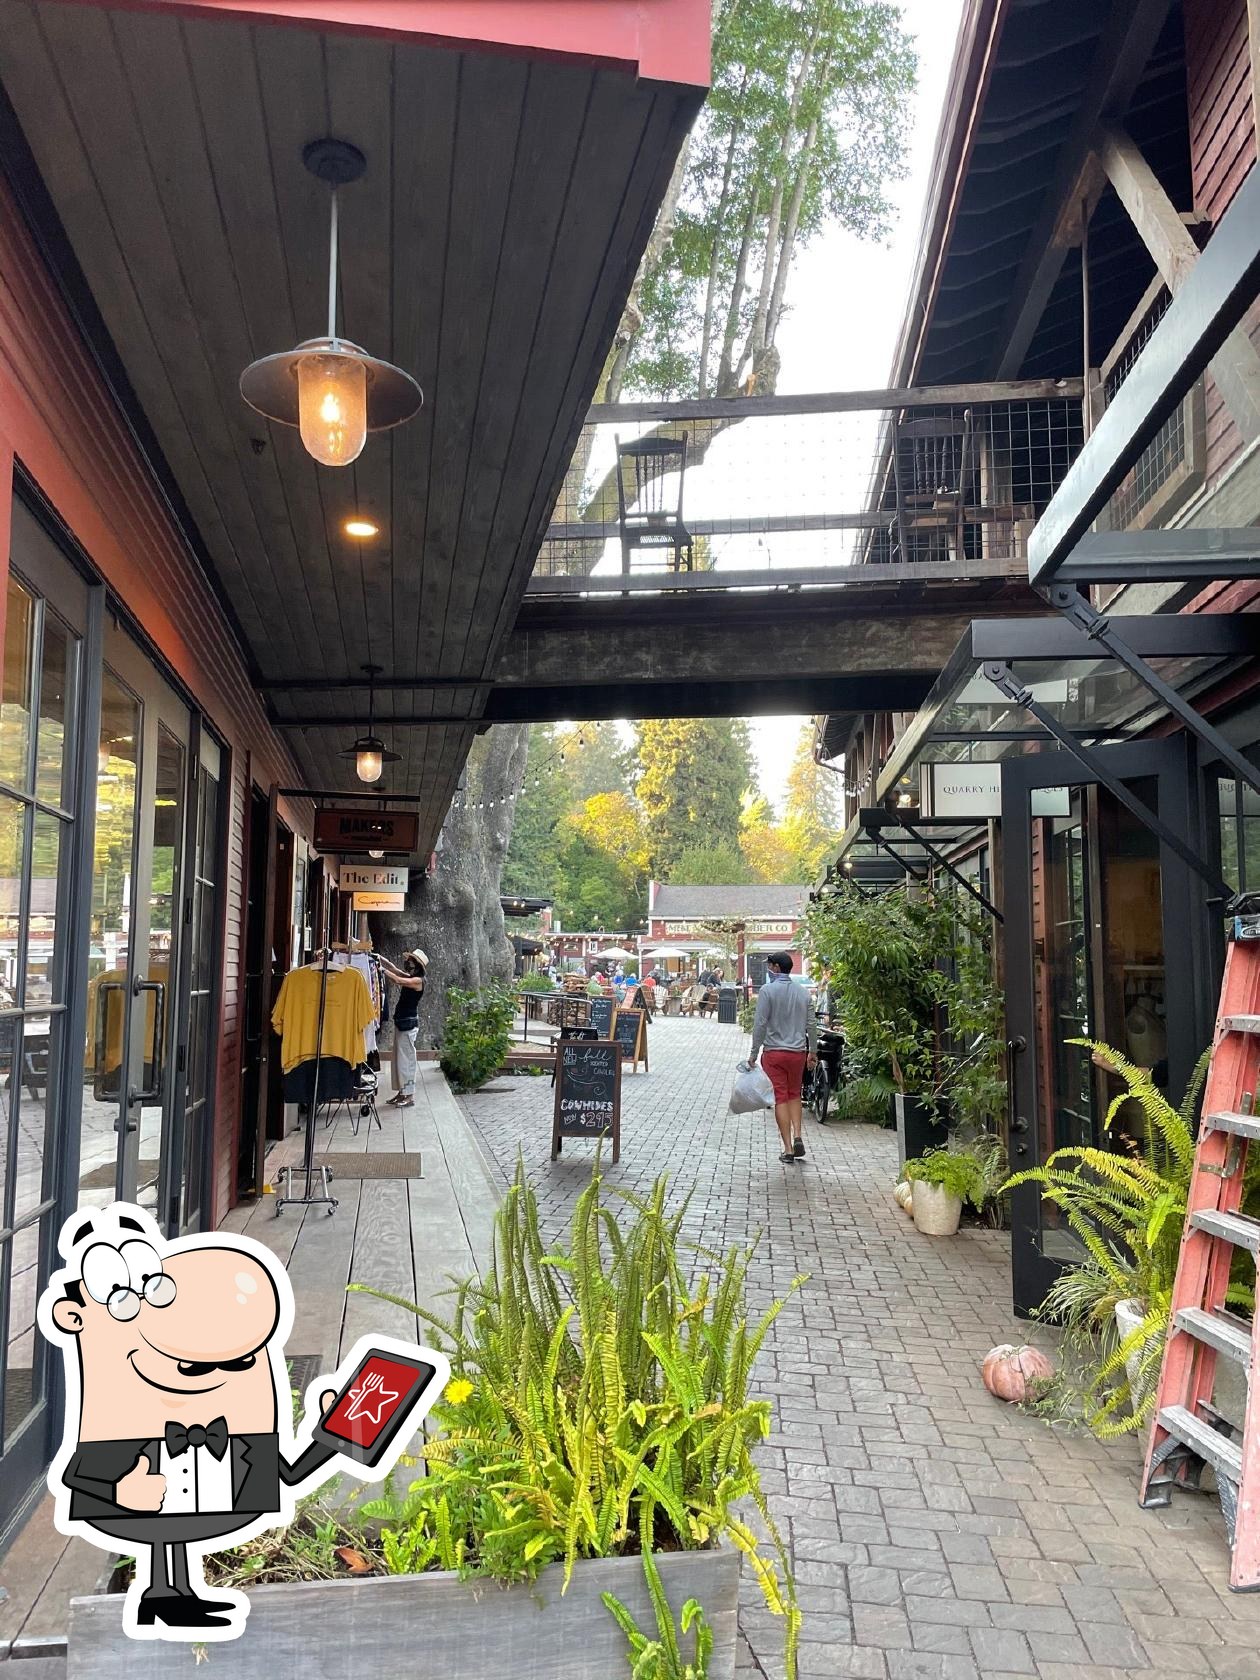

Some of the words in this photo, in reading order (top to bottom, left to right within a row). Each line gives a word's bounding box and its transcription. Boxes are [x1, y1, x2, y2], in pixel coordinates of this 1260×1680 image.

[943, 785, 985, 795] QUARRY
[339, 816, 394, 836] MAKERS
[343, 871, 369, 884] The
[563, 1046, 576, 1056] ALL
[563, 1055, 577, 1065] NEW
[560, 1098, 614, 1112] COWHIDES
[563, 1113, 577, 1124] NOW
[580, 1111, 614, 1129] $295
